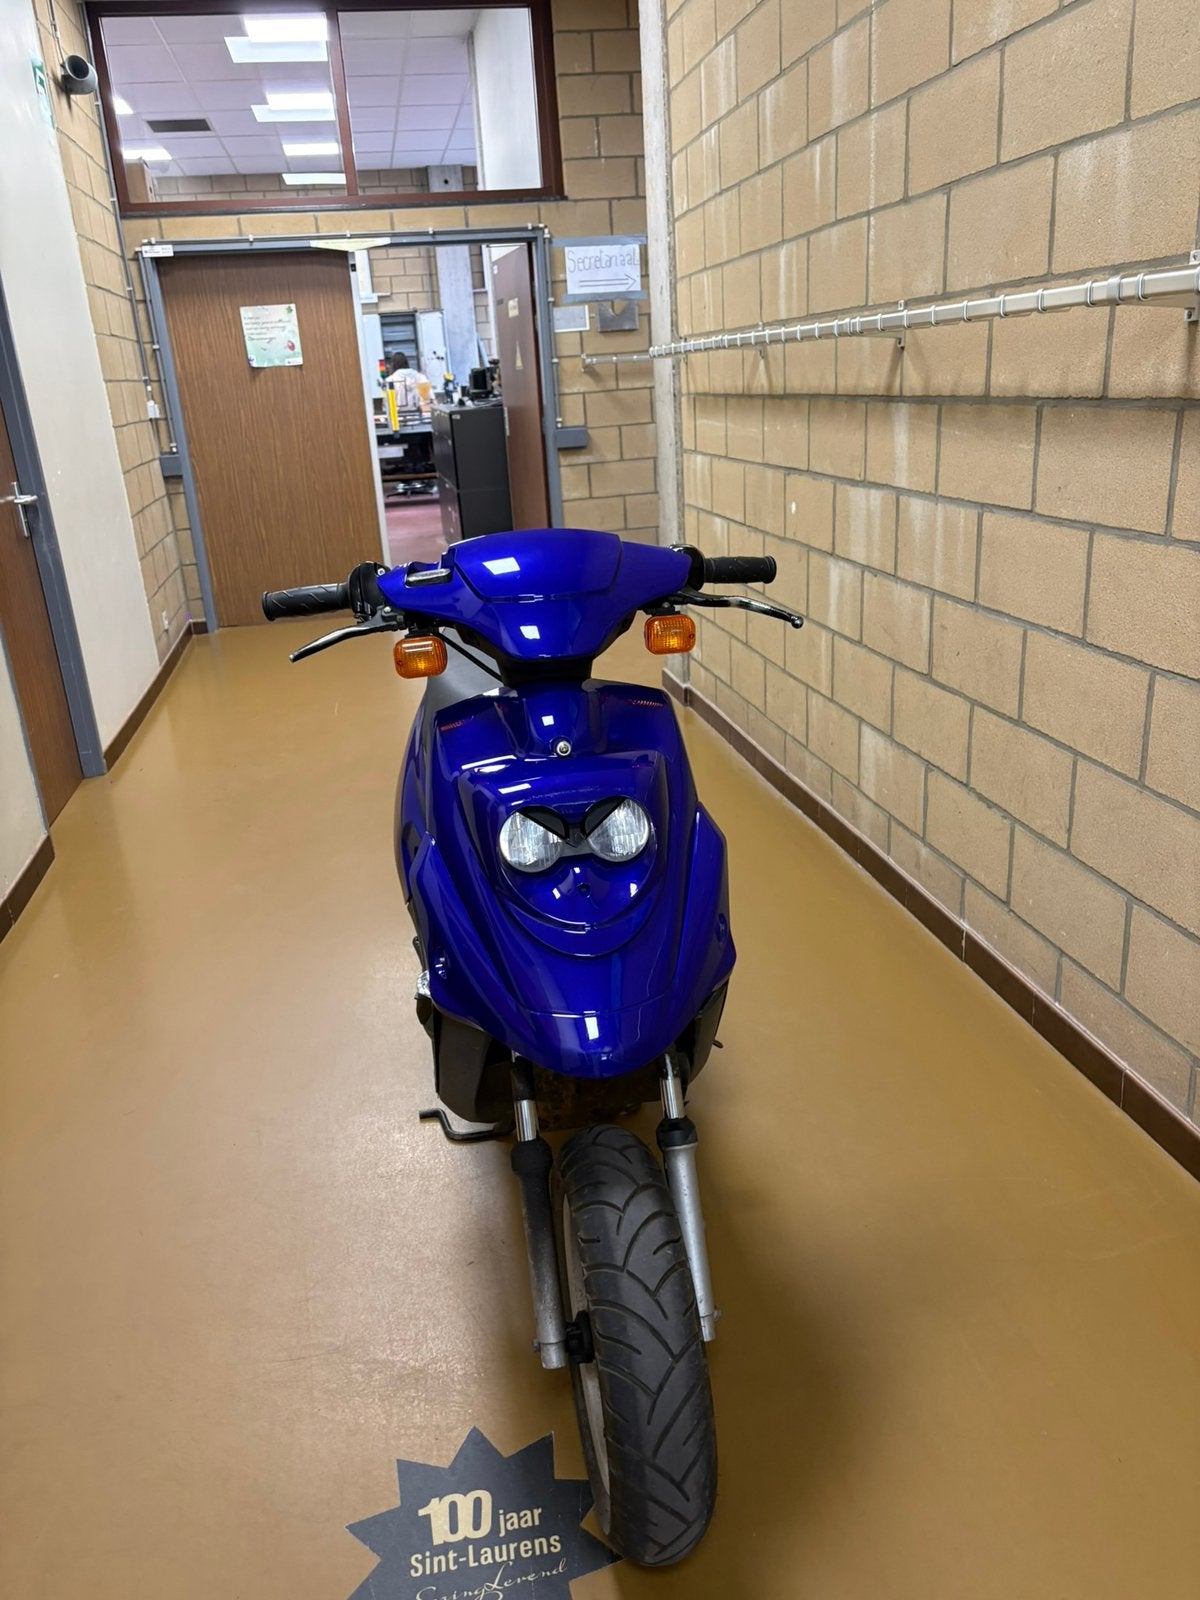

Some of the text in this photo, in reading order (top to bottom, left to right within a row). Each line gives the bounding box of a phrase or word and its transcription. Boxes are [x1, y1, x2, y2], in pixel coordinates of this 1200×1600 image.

[418, 1490, 543, 1546] 100 jaar
[410, 1534, 562, 1578] Sint-Laurens
